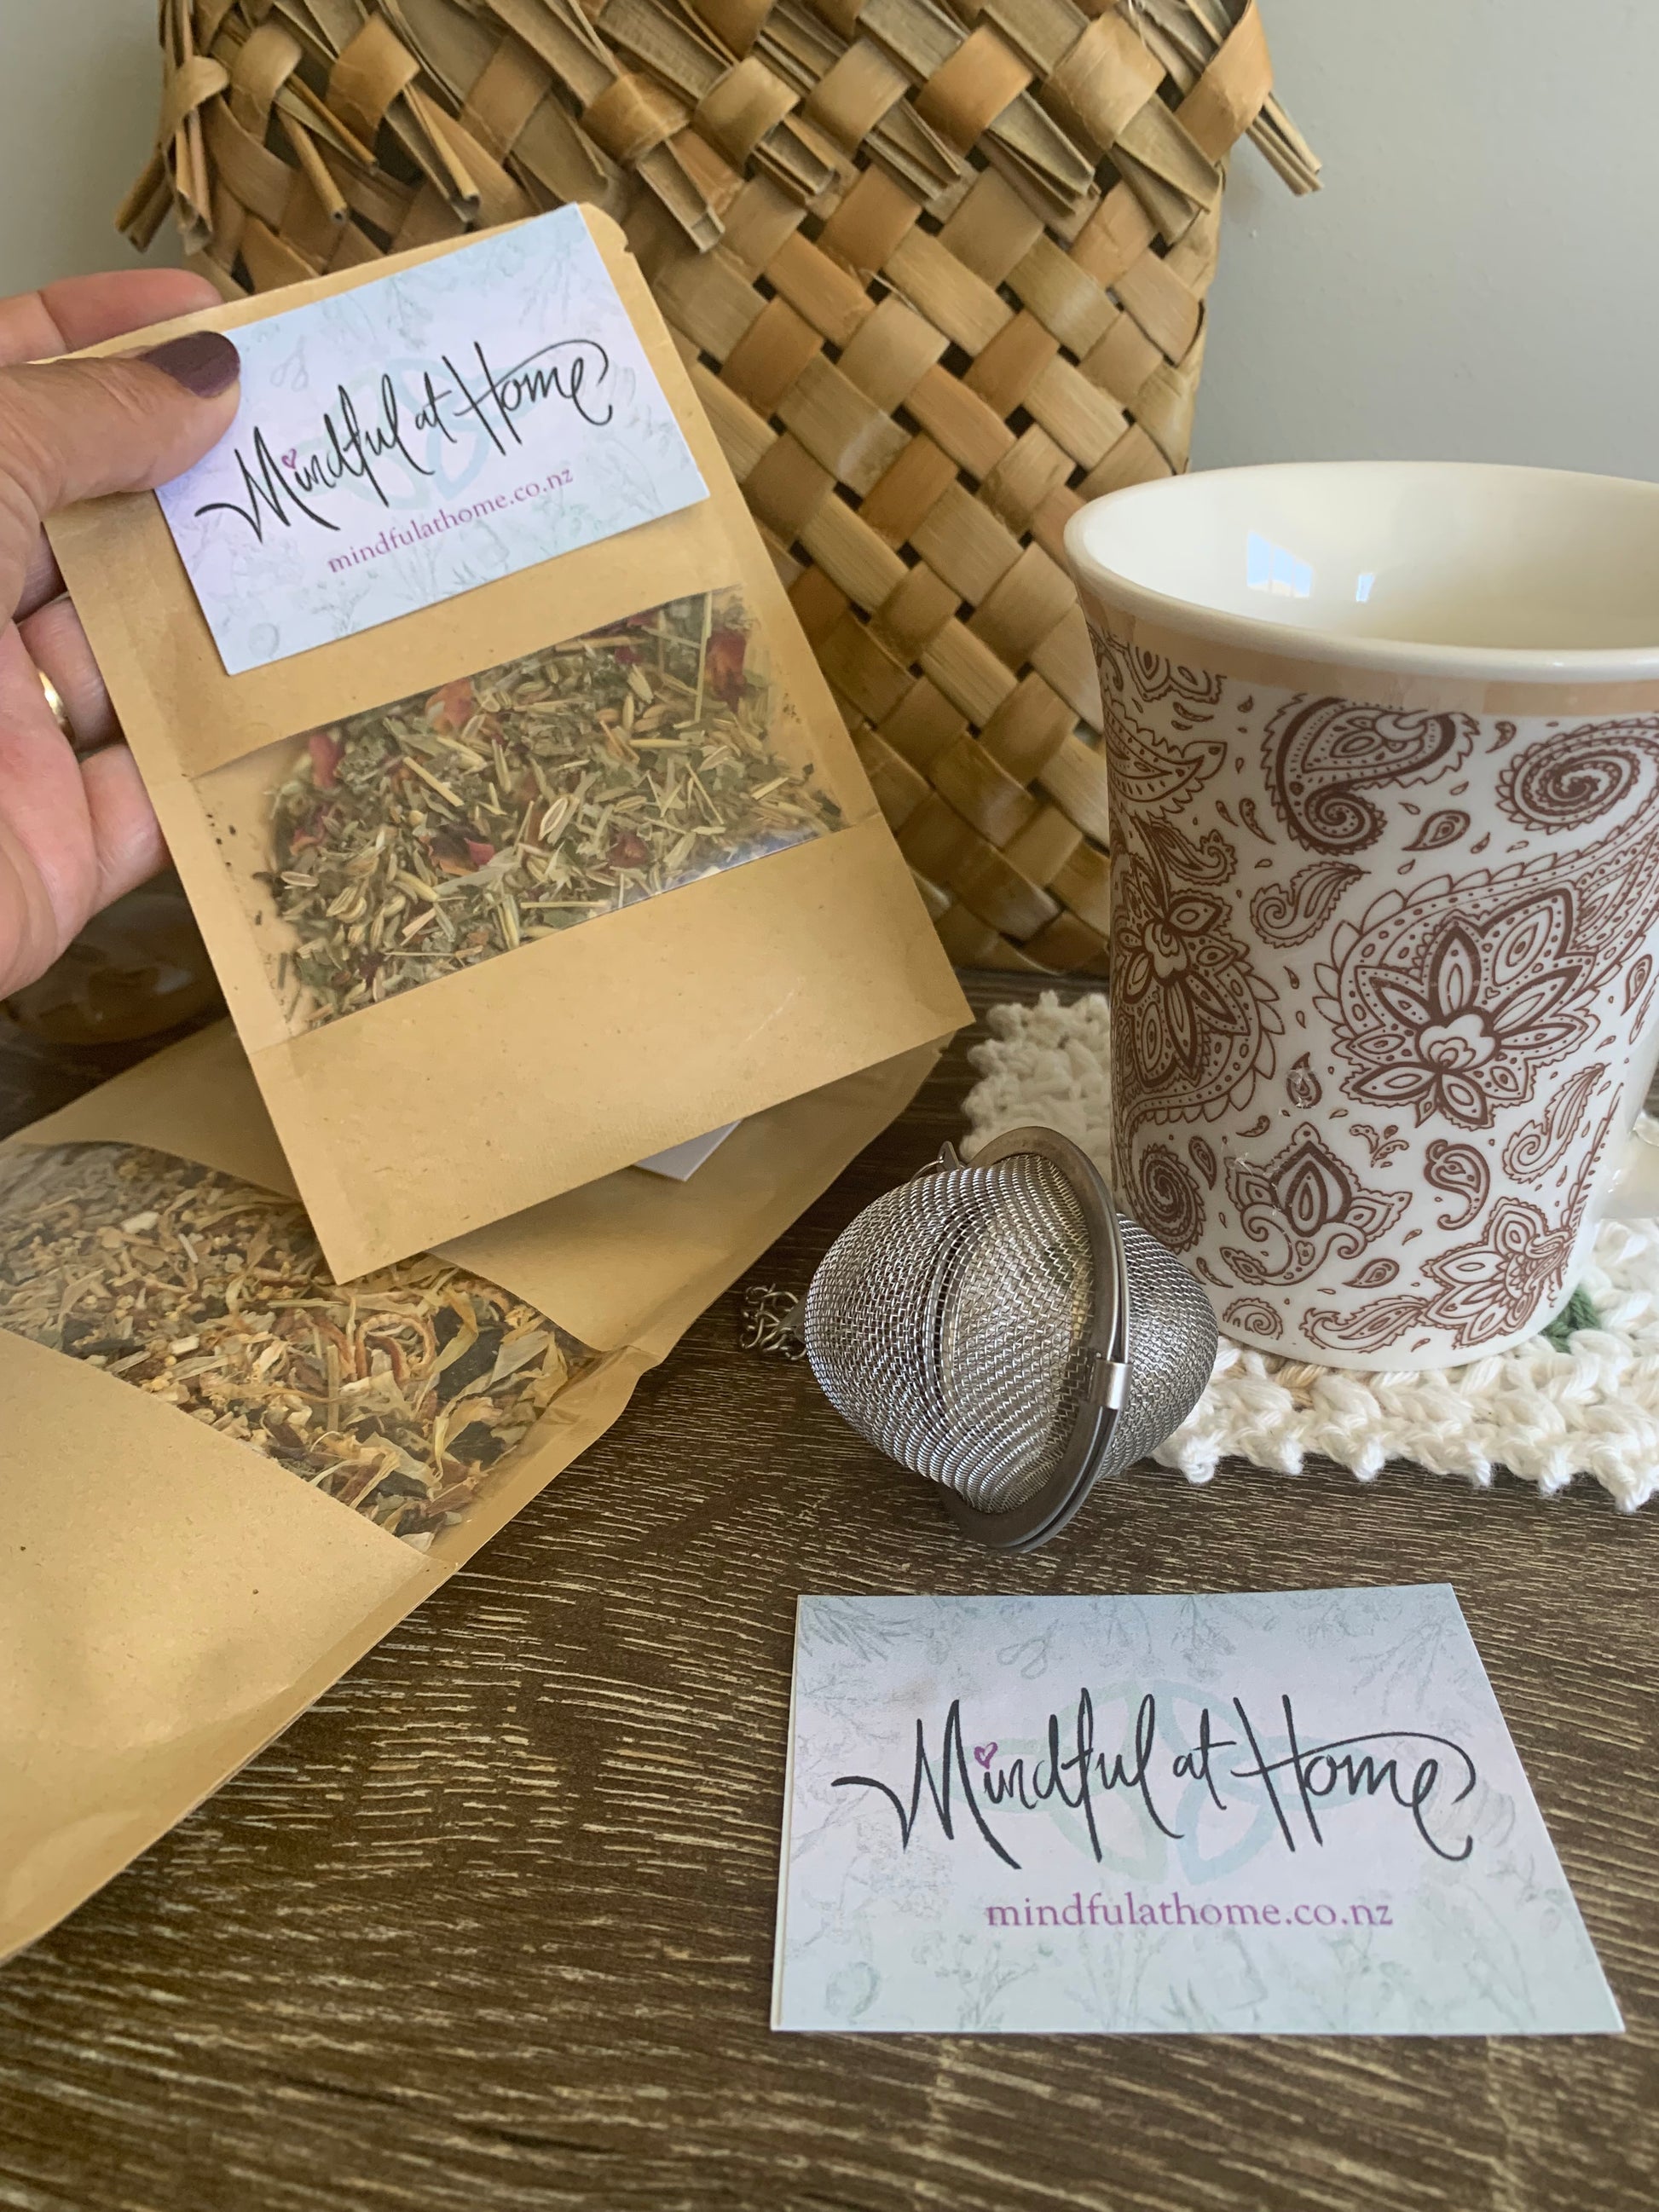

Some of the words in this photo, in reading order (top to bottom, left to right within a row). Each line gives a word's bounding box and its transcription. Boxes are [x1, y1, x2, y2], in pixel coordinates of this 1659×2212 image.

[195, 374, 435, 543] Mindful
[415, 372, 457, 443] at
[442, 338, 613, 456] Home
[327, 466, 575, 574] mindfulathome.co.nz
[831, 1688, 1185, 1869] Mindful
[1172, 1708, 1236, 1810] at
[1231, 1695, 1477, 1862] Home
[986, 1892, 1394, 1928] mindfulathome.co.nz
